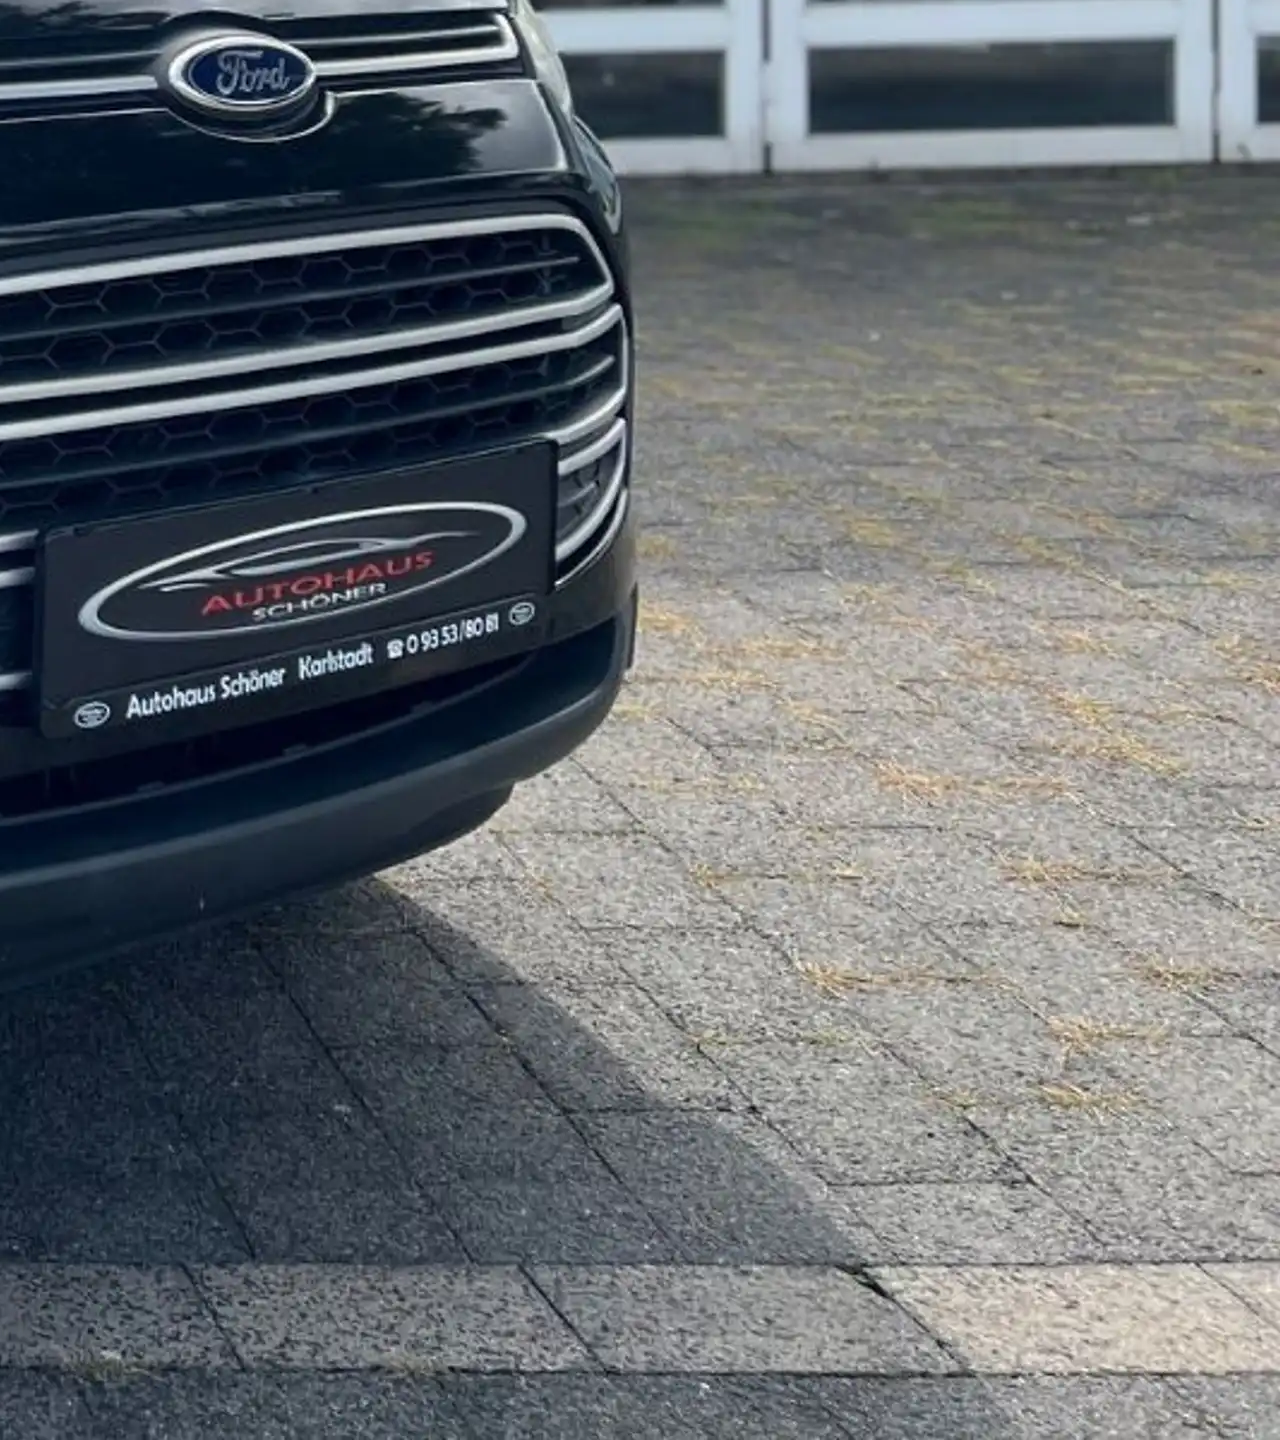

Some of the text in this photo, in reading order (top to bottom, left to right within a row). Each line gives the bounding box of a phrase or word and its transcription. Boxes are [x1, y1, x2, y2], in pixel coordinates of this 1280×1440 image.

[215, 50, 290, 96] Ford
[201, 551, 434, 617] AUTOHAUS
[251, 582, 387, 621] SCHÖNER
[125, 683, 216, 719] Autohaus
[219, 667, 287, 698] Schöner
[298, 641, 374, 680] Karlstadt
